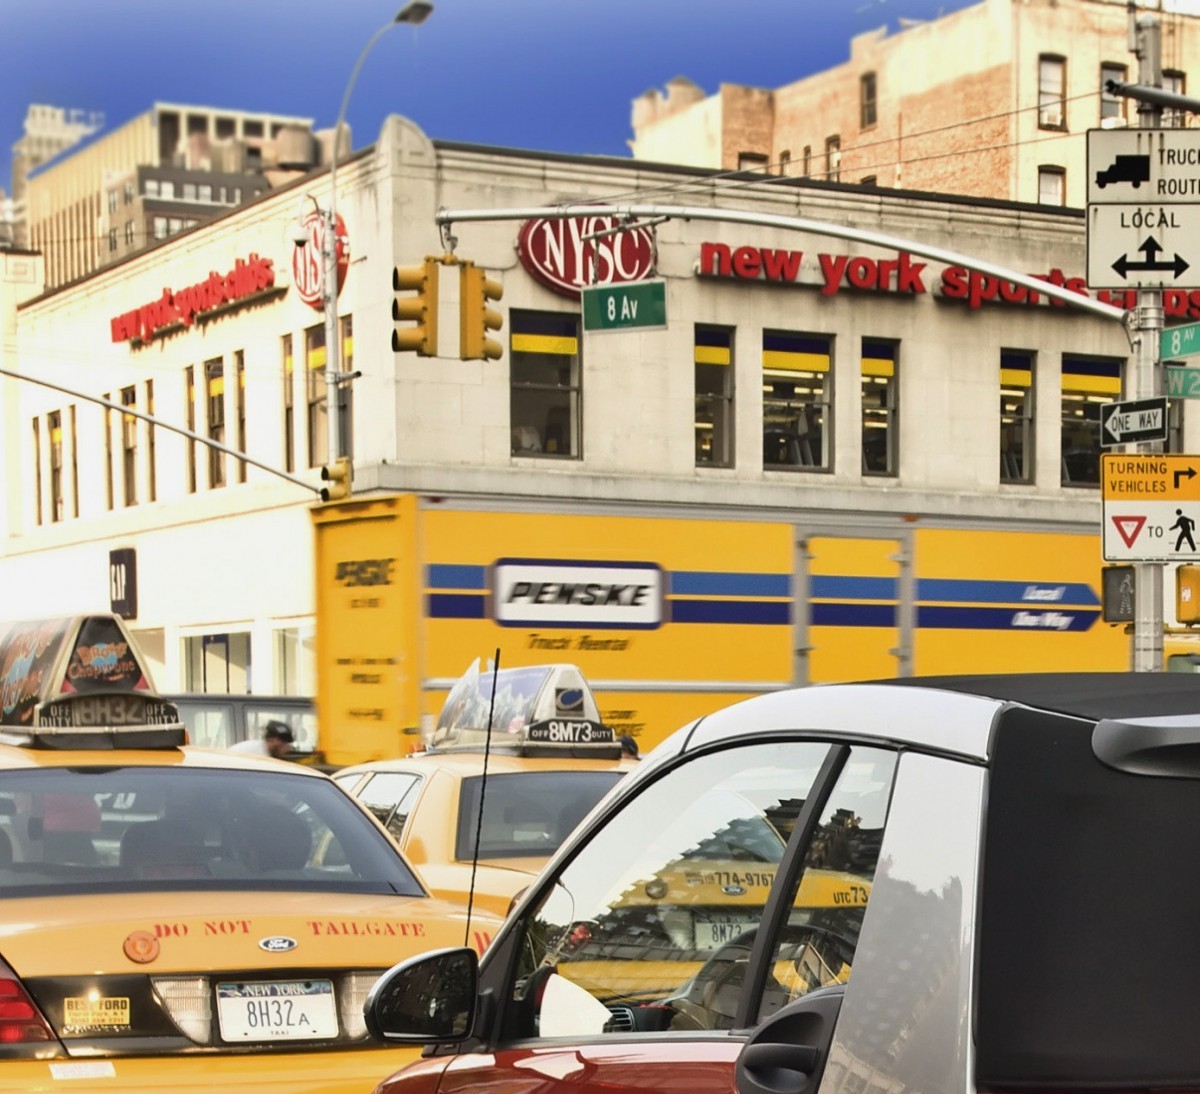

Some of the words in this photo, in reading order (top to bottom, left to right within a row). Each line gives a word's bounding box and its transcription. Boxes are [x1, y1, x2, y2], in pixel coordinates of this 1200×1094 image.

[1121, 212, 1180, 228] LOCAL
[295, 217, 349, 297] NYS
[543, 215, 640, 286] NYSC
[701, 242, 803, 282] new
[818, 251, 927, 296] york
[942, 266, 1089, 309] sports
[608, 296, 616, 321] 8
[1172, 330, 1181, 354] 8
[1184, 328, 1195, 341] AV
[1167, 370, 1184, 394] W
[1111, 415, 1130, 432] ONE
[1139, 411, 1158, 428] WAY
[1110, 462, 1167, 474] TURNING
[1110, 481, 1166, 492] VEHICLES
[1148, 526, 1163, 538] TO
[507, 582, 652, 606] PENSKE
[50, 704, 70, 716] OFF
[81, 698, 142, 724] 8H32
[147, 704, 165, 715] OFF
[41, 716, 72, 727] DUTY
[147, 714, 177, 726] DUTY
[532, 730, 549, 738] OFF
[549, 722, 592, 742] 8M73
[592, 731, 612, 739] DUTY
[155, 923, 188, 938] DO
[204, 920, 251, 935] NOT
[306, 921, 425, 937] TAILGATE
[246, 984, 272, 996] NEW
[275, 983, 305, 996] YORK
[67, 1001, 96, 1010] BES
[99, 1000, 127, 1010] FORD
